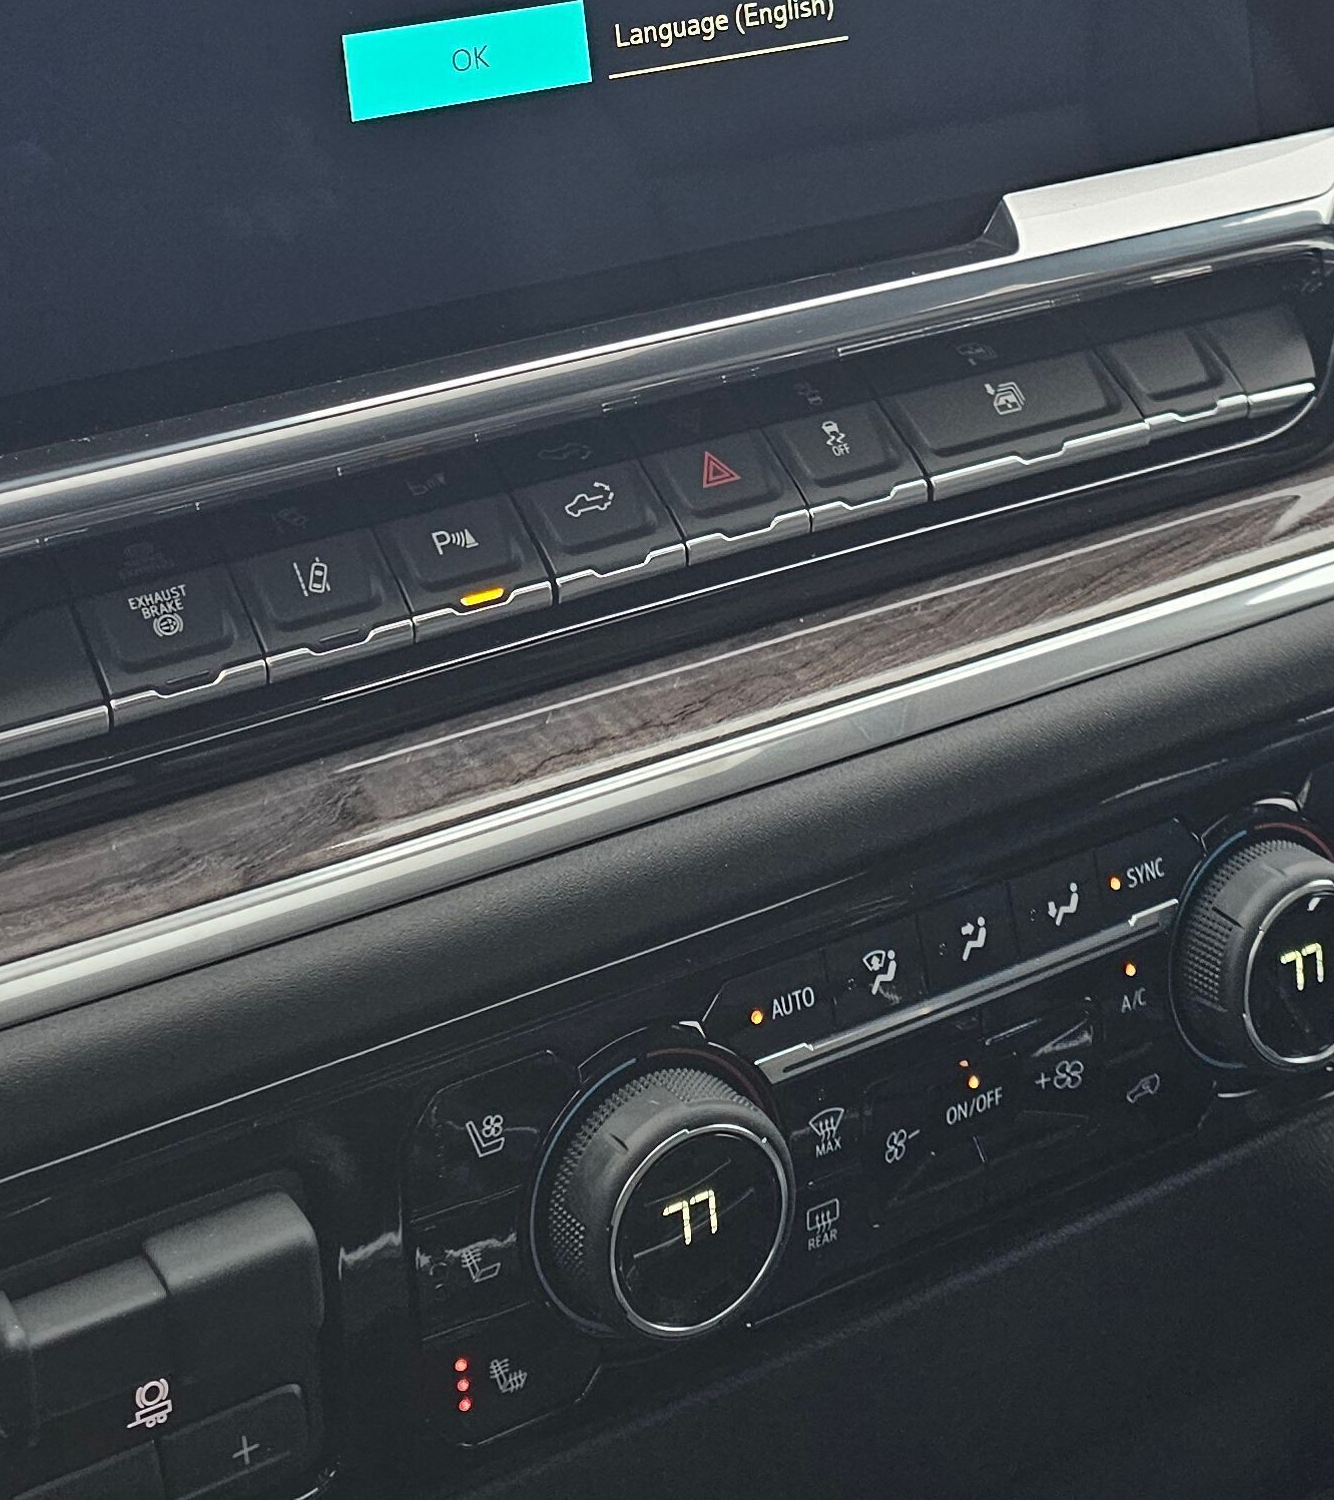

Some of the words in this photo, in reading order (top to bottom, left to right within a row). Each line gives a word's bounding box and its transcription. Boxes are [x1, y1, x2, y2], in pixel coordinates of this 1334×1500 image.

[615, 10, 729, 49] Language
[452, 44, 490, 73] OK
[127, 584, 187, 611] EXHAUST
[141, 598, 184, 620] BRAKE
[1126, 857, 1165, 889] SYNC
[1279, 942, 1325, 992] 77
[771, 986, 815, 1020] AUTO
[1120, 987, 1148, 1014] A/C
[945, 1086, 1004, 1126] ON/OFF
[815, 1136, 843, 1159] MAX
[662, 1189, 718, 1246] 77
[807, 1228, 838, 1251] REAR
